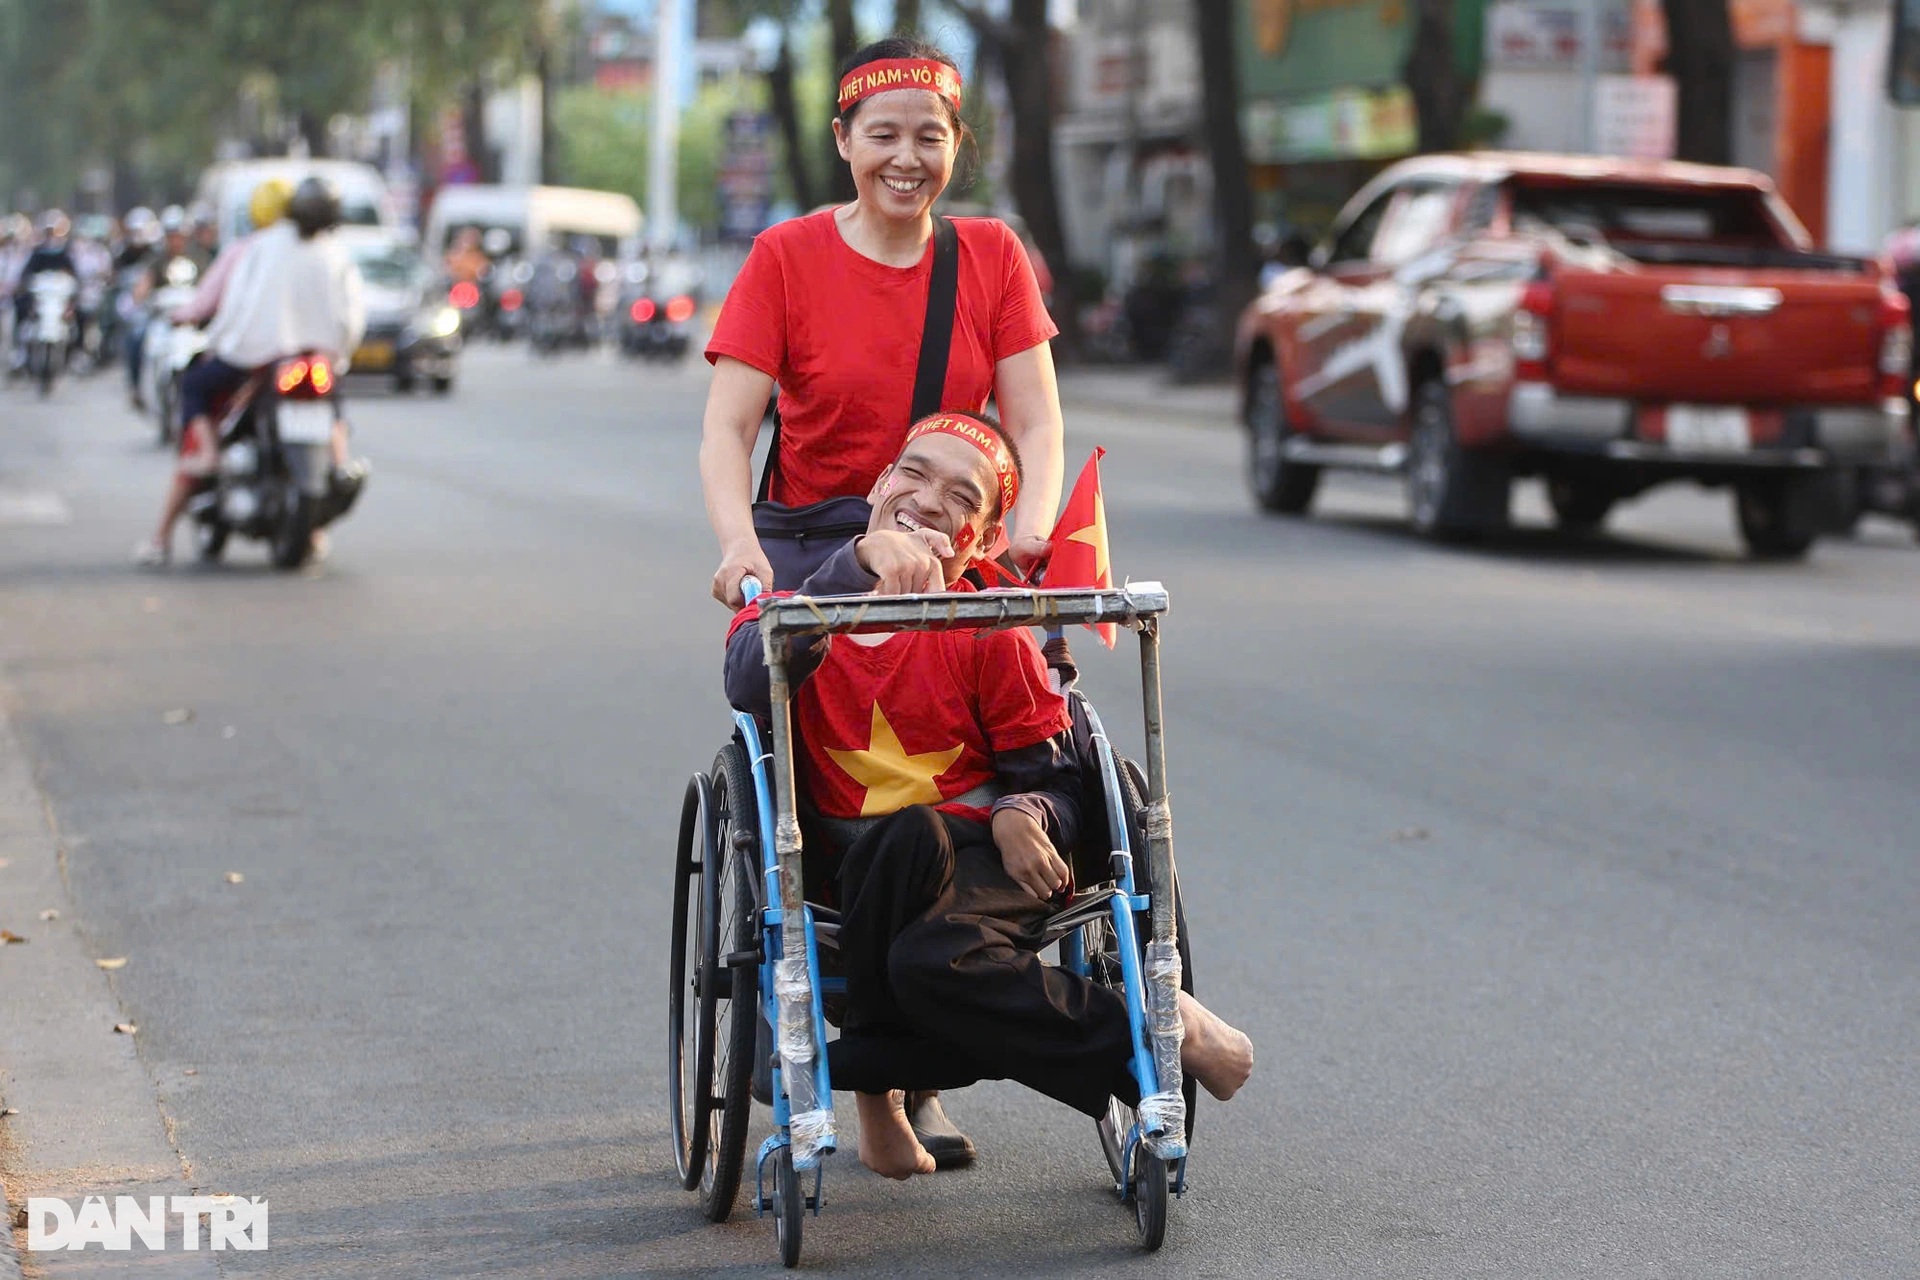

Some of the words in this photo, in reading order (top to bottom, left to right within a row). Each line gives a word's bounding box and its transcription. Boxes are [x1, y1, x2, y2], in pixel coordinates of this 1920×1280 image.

[843, 76, 864, 100] VIỆT
[867, 69, 902, 89] NAM
[910, 66, 932, 83] VÔ
[920, 418, 953, 432] VIỆT
[954, 421, 992, 449] NAM
